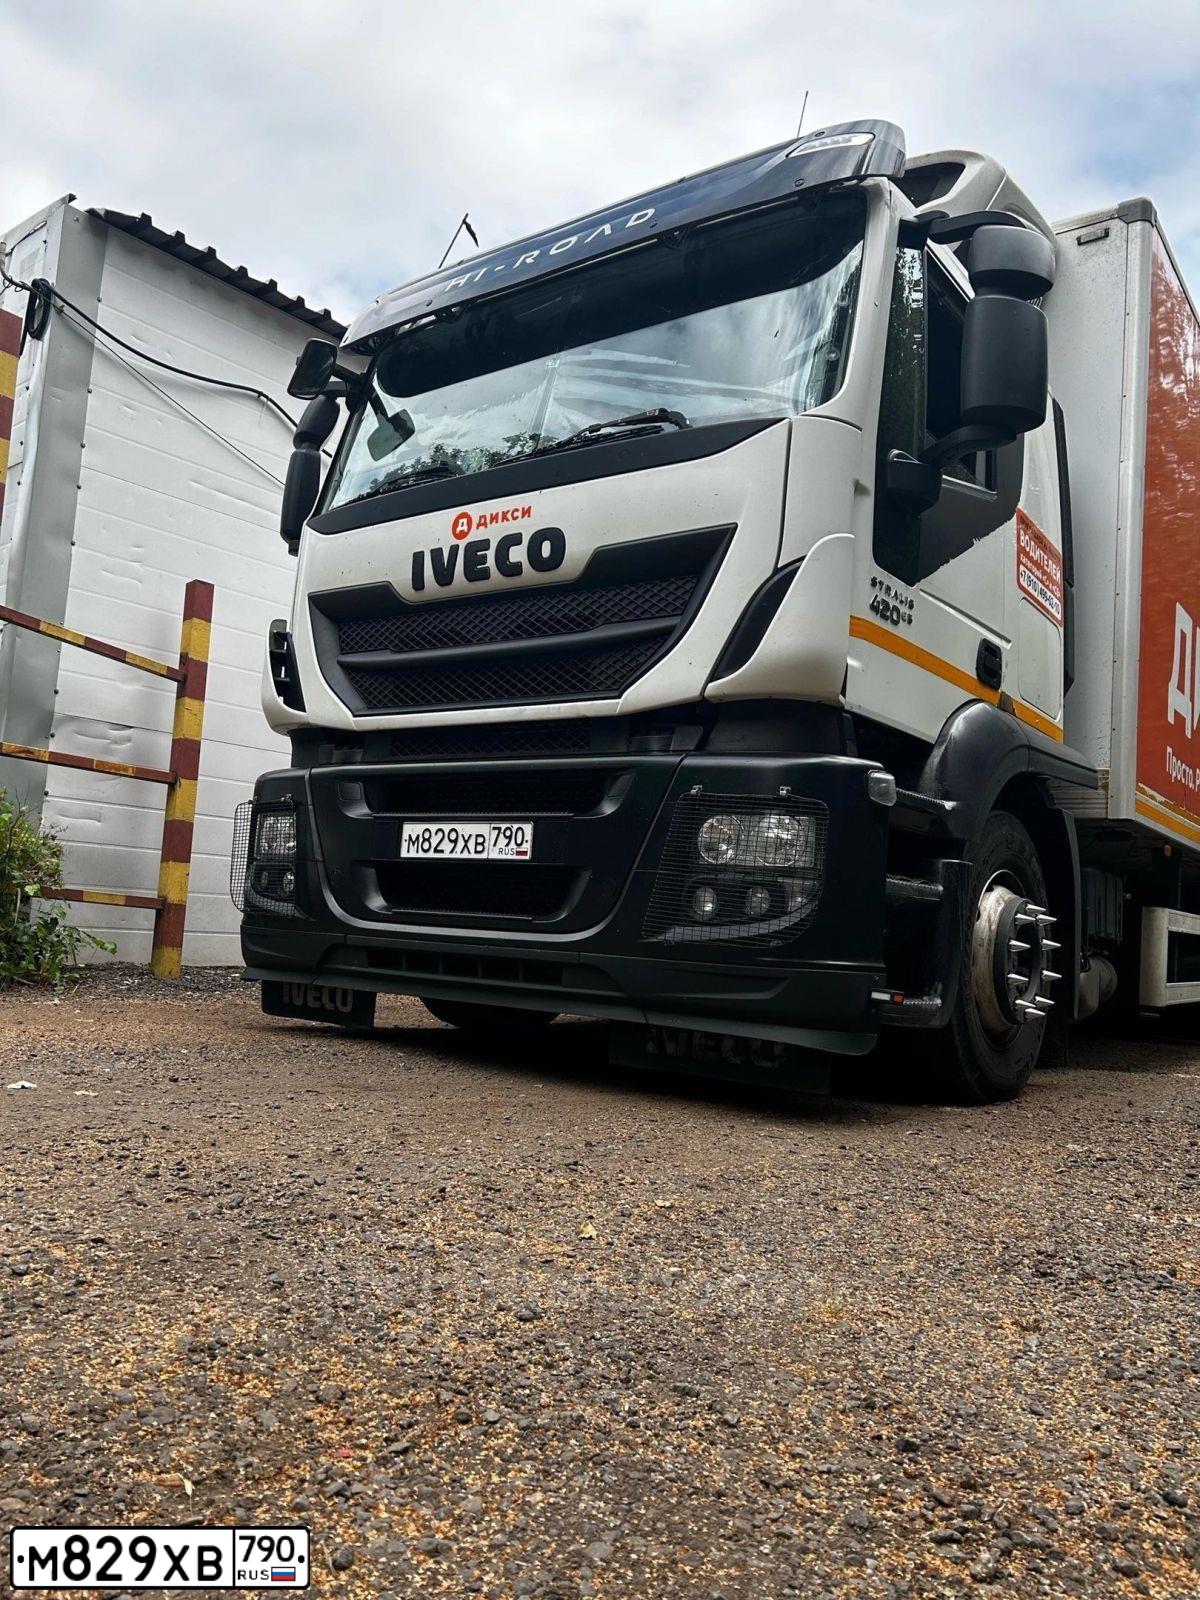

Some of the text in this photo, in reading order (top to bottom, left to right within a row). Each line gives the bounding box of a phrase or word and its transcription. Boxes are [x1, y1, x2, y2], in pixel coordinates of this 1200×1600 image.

[476, 505, 532, 530] ДИКСИ
[411, 526, 566, 592] IVECO
[1020, 528, 1061, 585] ВОДИТЕЛЕЙ
[492, 826, 525, 848] 790
[498, 847, 515, 856] RUS
